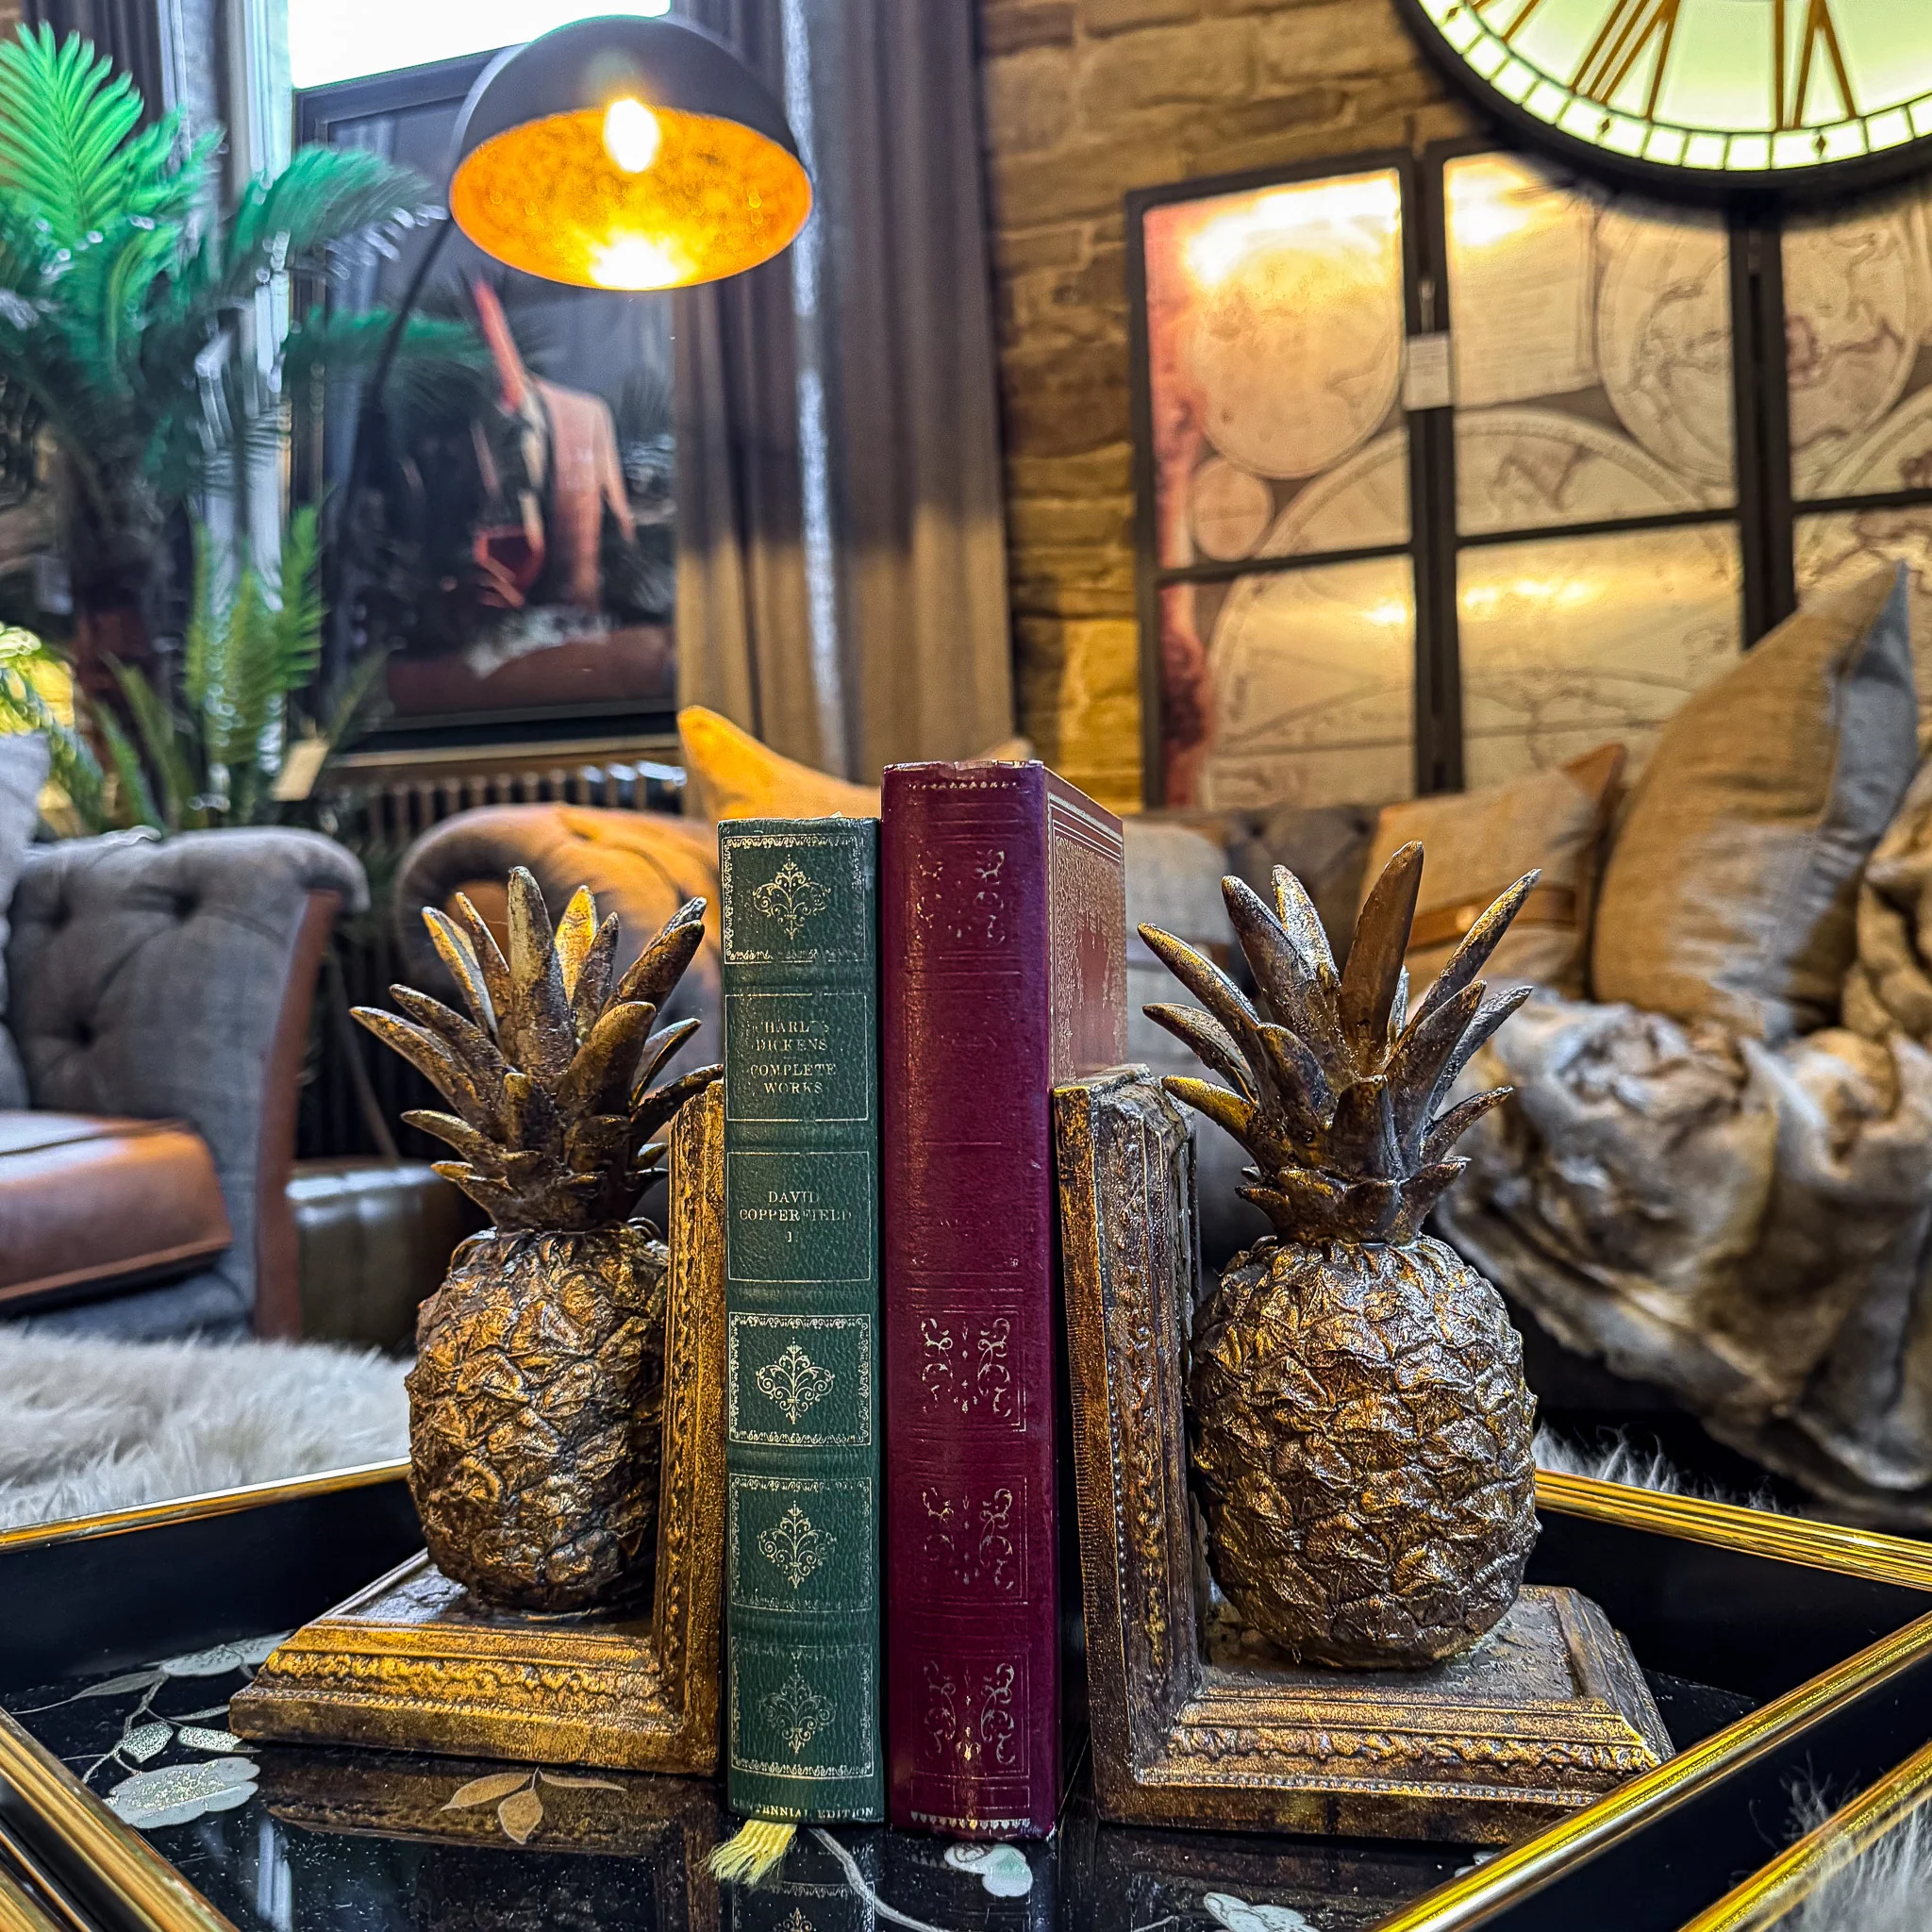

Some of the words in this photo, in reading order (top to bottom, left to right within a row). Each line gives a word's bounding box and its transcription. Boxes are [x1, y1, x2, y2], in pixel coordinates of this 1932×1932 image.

[750, 1062, 836, 1077] COMPLETE
[763, 1081, 824, 1094] WORKS
[768, 1191, 820, 1204] DAVID
